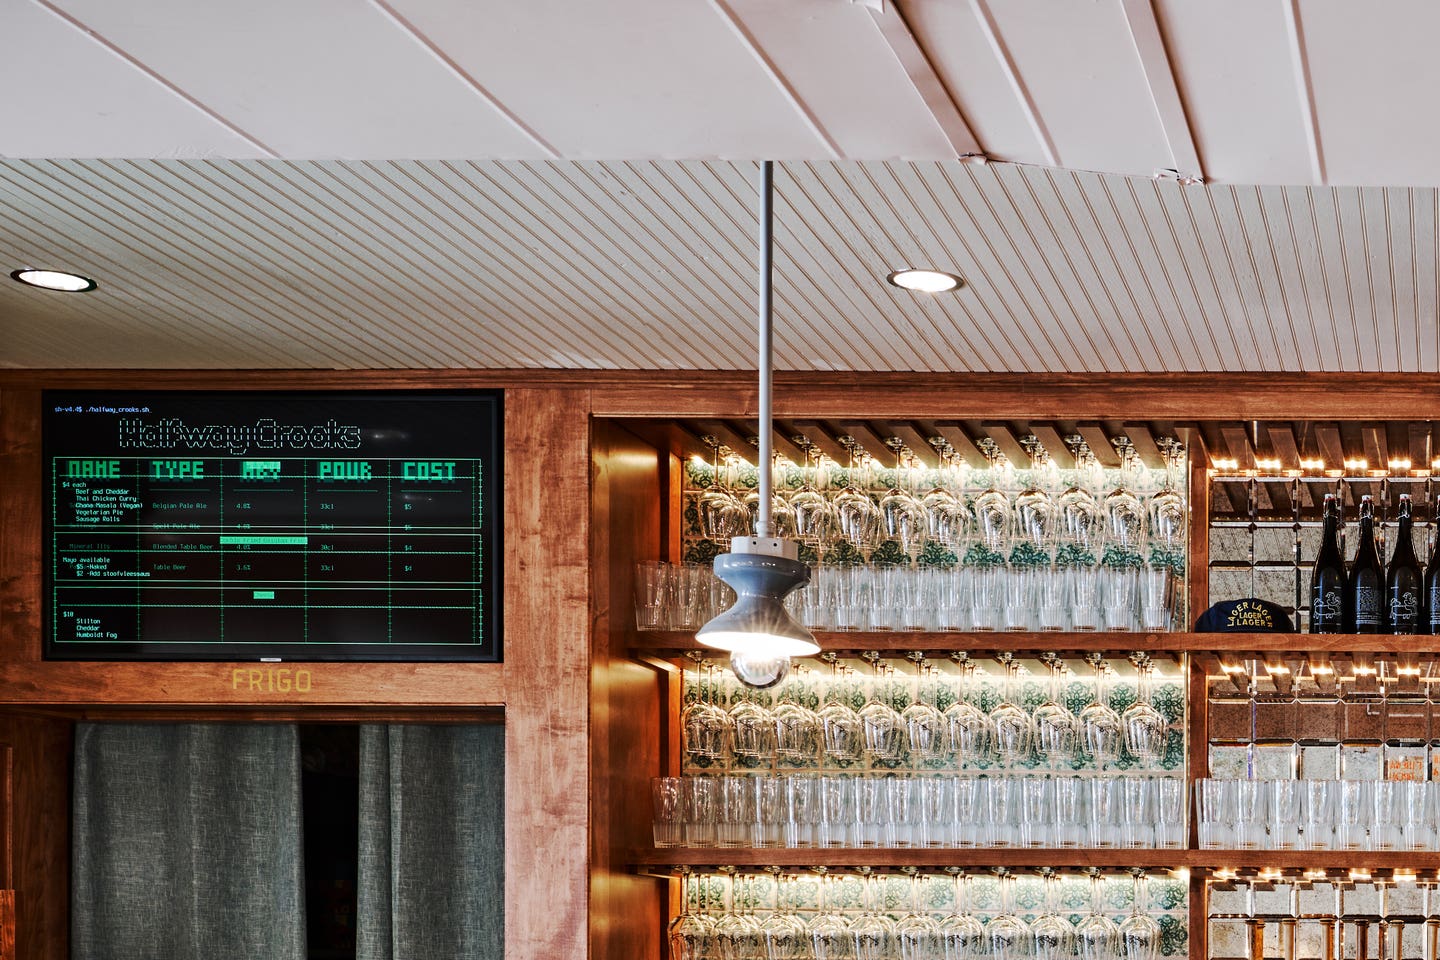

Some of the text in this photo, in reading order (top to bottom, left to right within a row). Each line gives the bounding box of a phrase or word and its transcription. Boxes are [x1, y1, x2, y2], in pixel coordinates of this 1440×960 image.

[68, 461, 120, 479] NAME
[152, 461, 204, 479] TYPE
[320, 461, 372, 480] POUR
[404, 462, 455, 480] COST
[1236, 619, 1266, 627] LAGER
[232, 668, 312, 692] FRIGO
